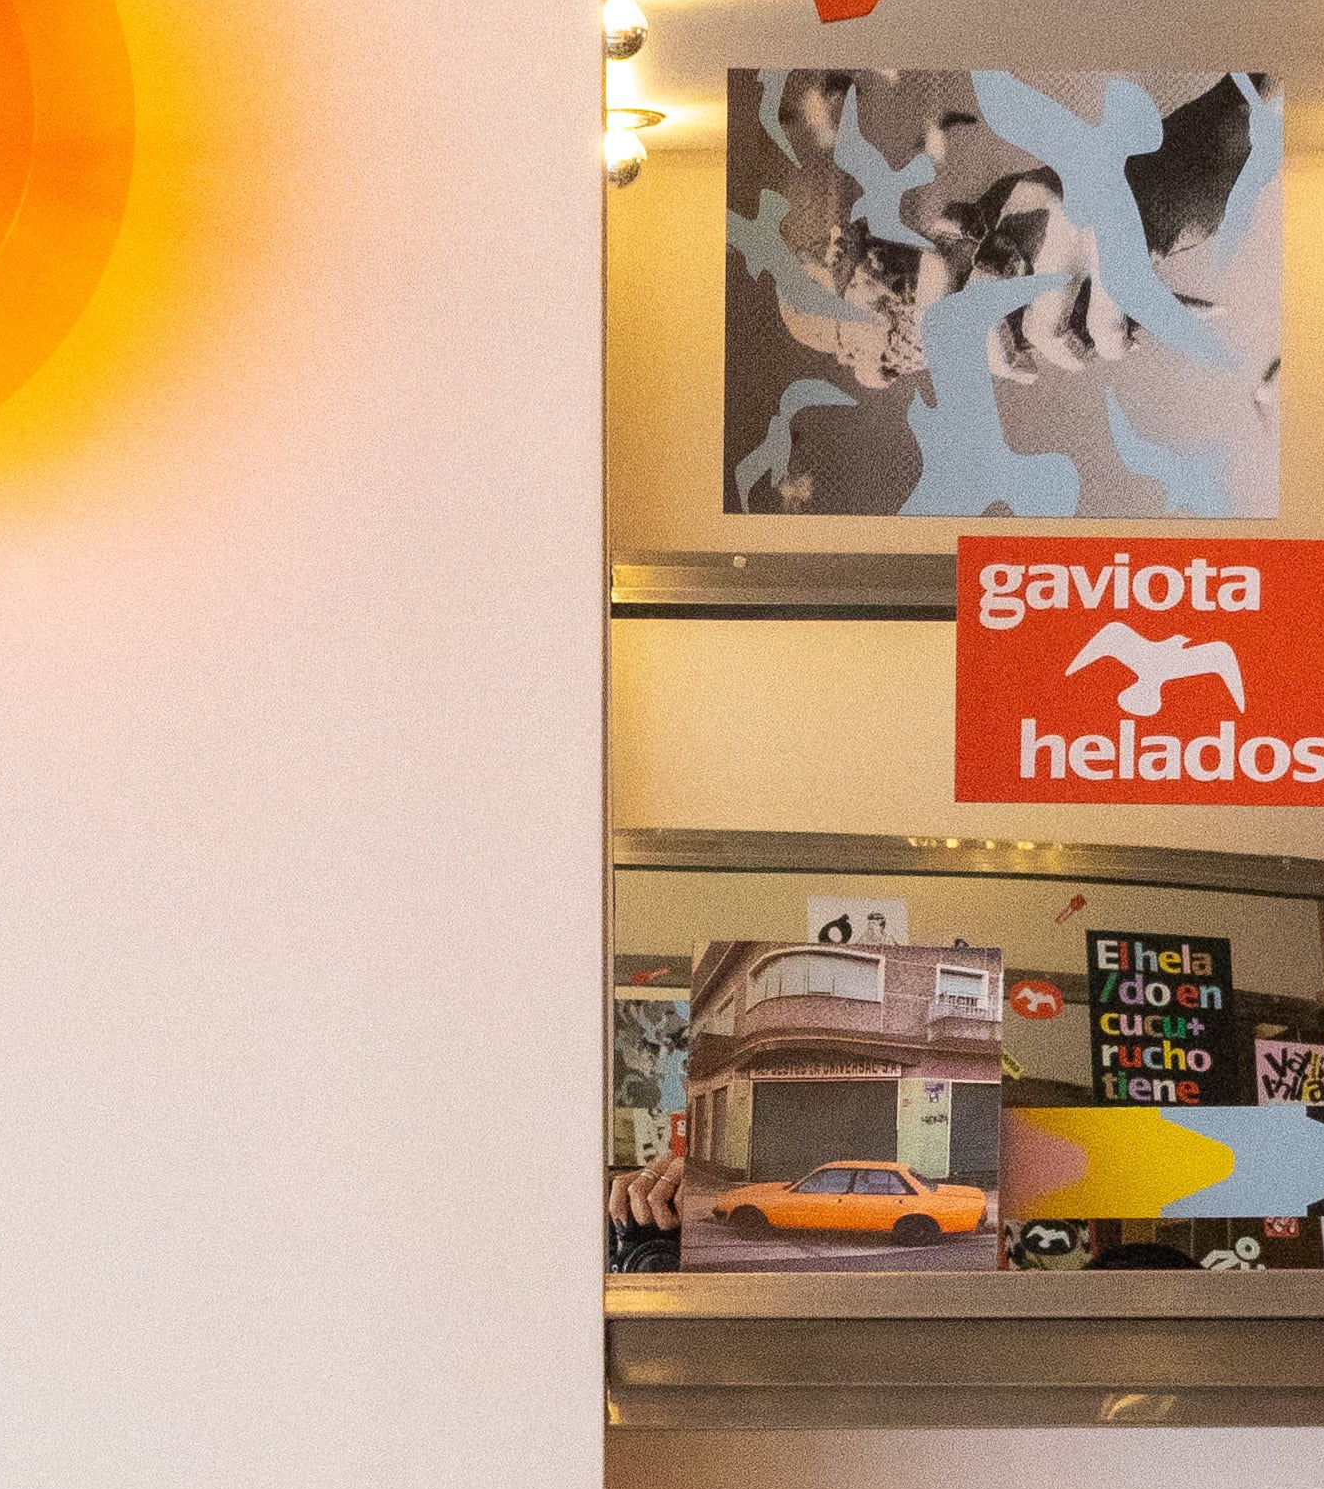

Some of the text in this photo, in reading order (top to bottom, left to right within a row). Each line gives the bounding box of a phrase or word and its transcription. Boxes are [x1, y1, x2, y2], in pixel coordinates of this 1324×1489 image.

[978, 552, 1262, 631] gaviota
[1096, 939, 1213, 976] El hela
[1176, 983, 1223, 1010] en
[1101, 1039, 1212, 1073] rucho
[1101, 1071, 1200, 1105] tiene
